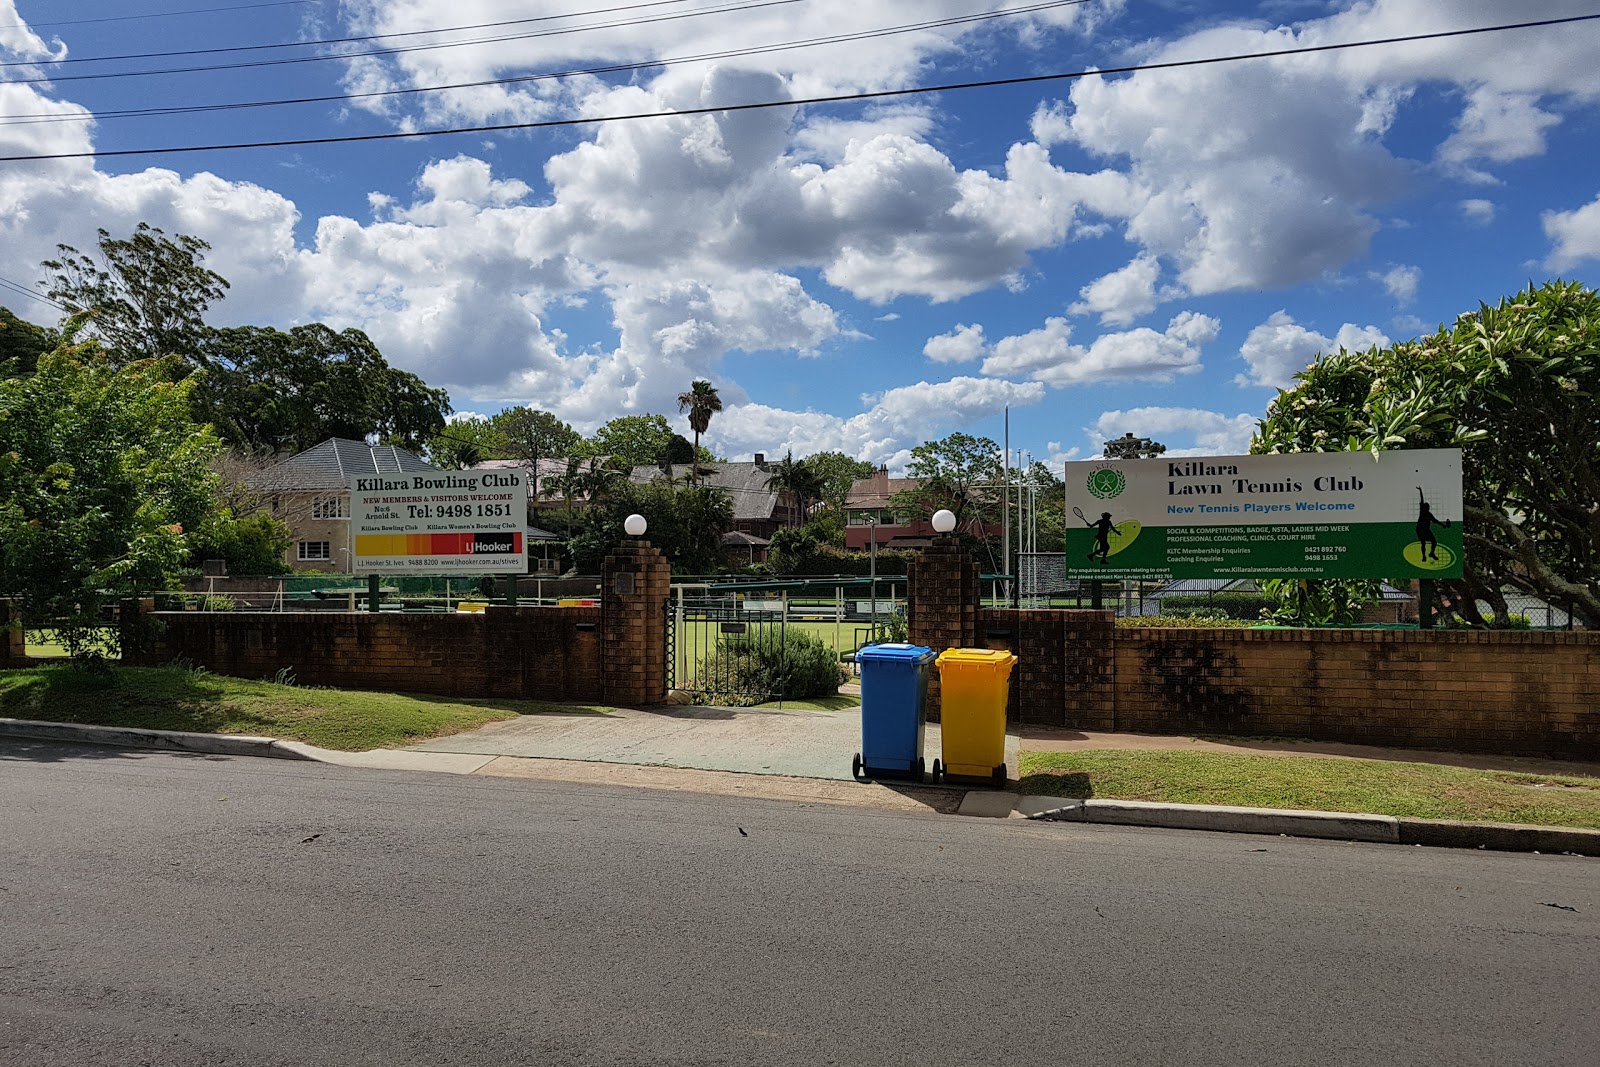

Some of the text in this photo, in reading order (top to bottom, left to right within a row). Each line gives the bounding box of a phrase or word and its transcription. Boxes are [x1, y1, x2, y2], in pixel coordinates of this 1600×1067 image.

[1095, 463, 1117, 471] KLTC
[1168, 462, 1238, 477] Killara
[357, 474, 519, 491] Killara Bowling Club
[1168, 476, 1363, 495] Lawn Tennis Club
[407, 504, 511, 518] Tel: 9498 1851
[1167, 502, 1355, 514] New Tennis Players Welcome
[475, 542, 512, 552] Hooker
